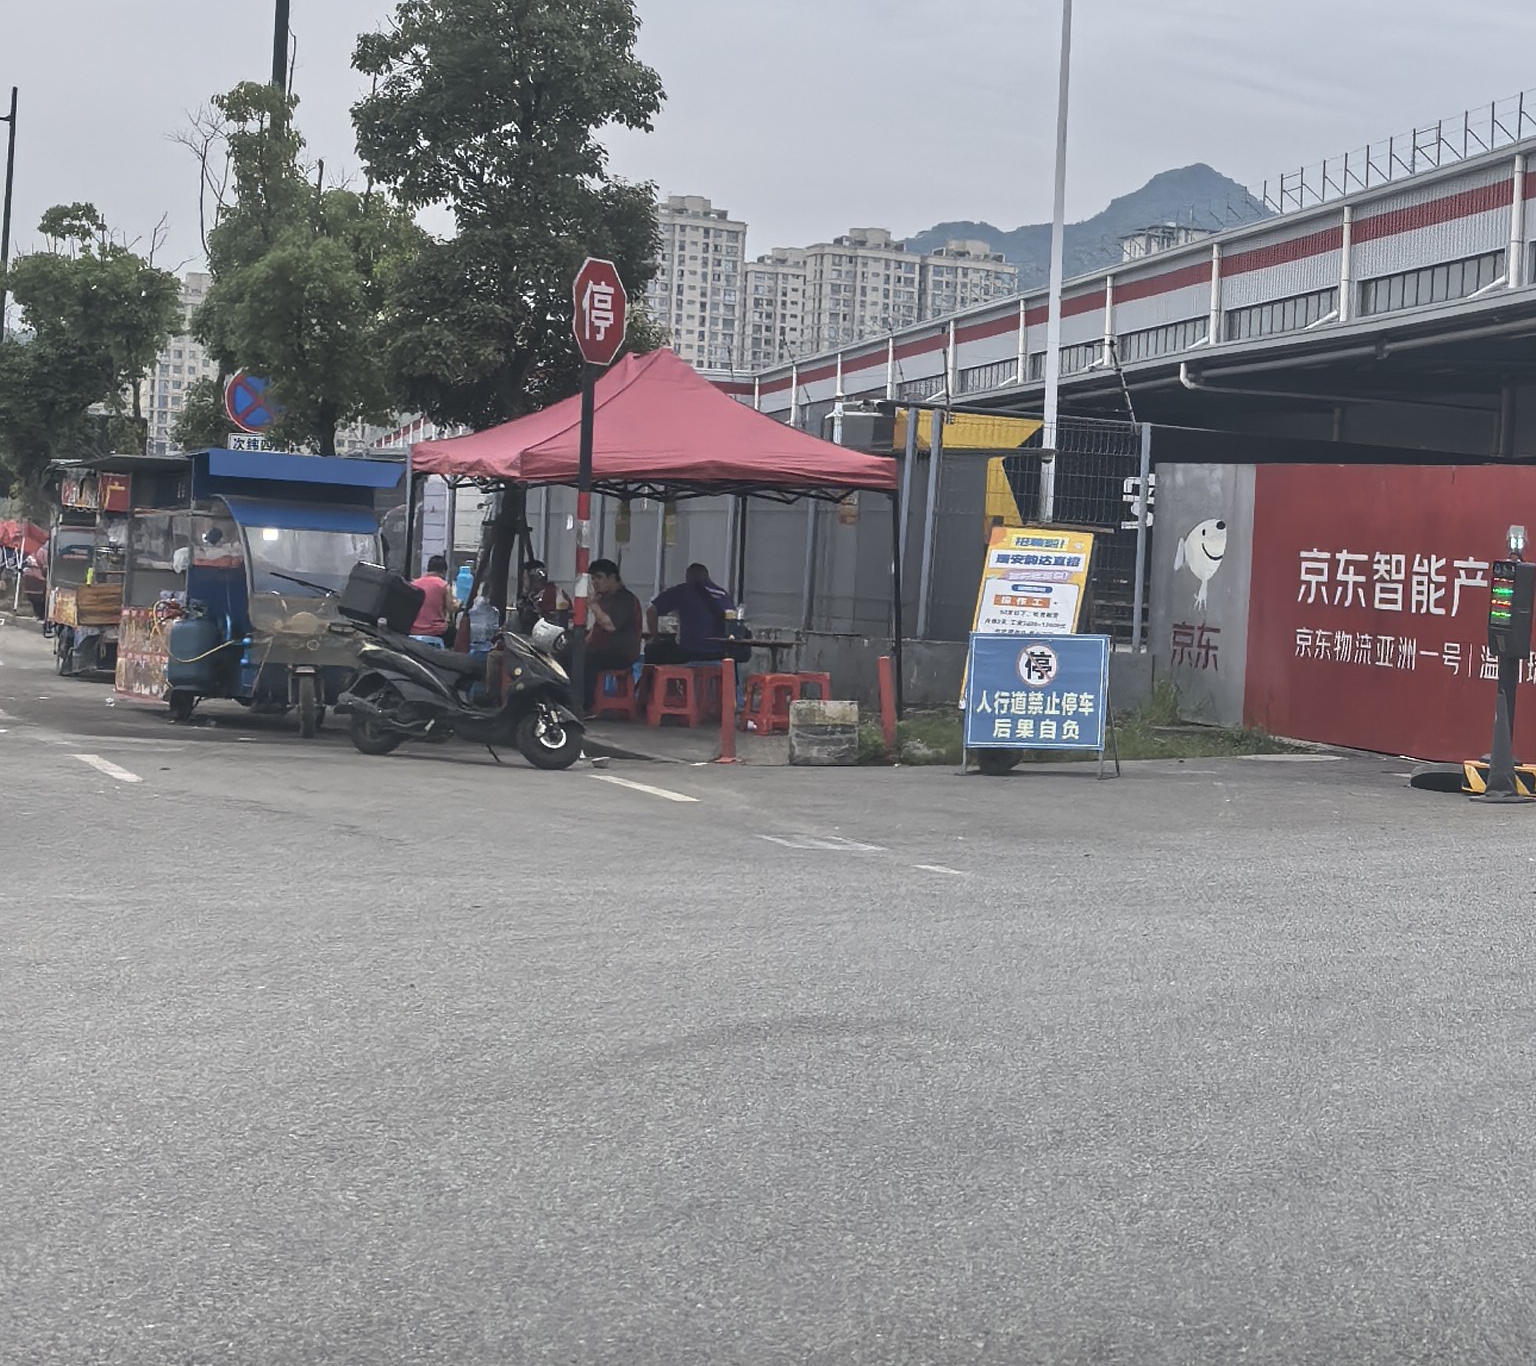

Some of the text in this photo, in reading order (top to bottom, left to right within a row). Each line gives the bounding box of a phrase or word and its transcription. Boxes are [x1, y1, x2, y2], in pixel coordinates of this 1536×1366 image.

[582, 280, 615, 341] 停
[1170, 619, 1221, 672] 京东
[1025, 651, 1052, 680] 停
[976, 690, 1094, 716] 人行道禁止停车
[993, 719, 1080, 739] 后果自负
